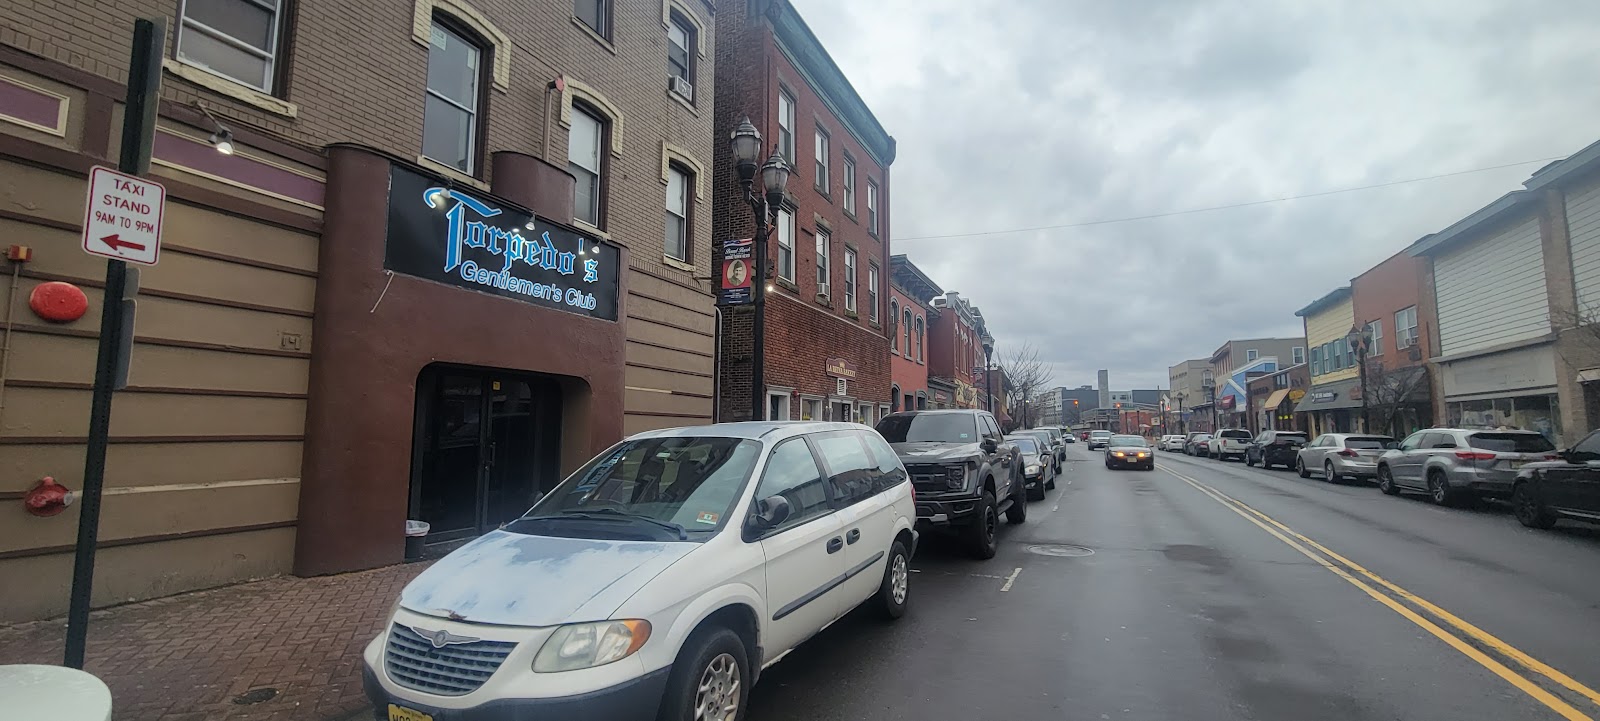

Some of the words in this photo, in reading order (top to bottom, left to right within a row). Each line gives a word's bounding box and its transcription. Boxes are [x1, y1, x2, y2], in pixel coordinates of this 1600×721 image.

[113, 178, 145, 196] TAXI
[102, 194, 151, 215] STAND
[95, 210, 115, 225] 9AM
[119, 216, 131, 229] TO
[135, 220, 154, 234] 9PM
[423, 187, 599, 284] Torpedo's
[460, 260, 562, 303] Gentlemen's
[564, 287, 597, 311] Club
